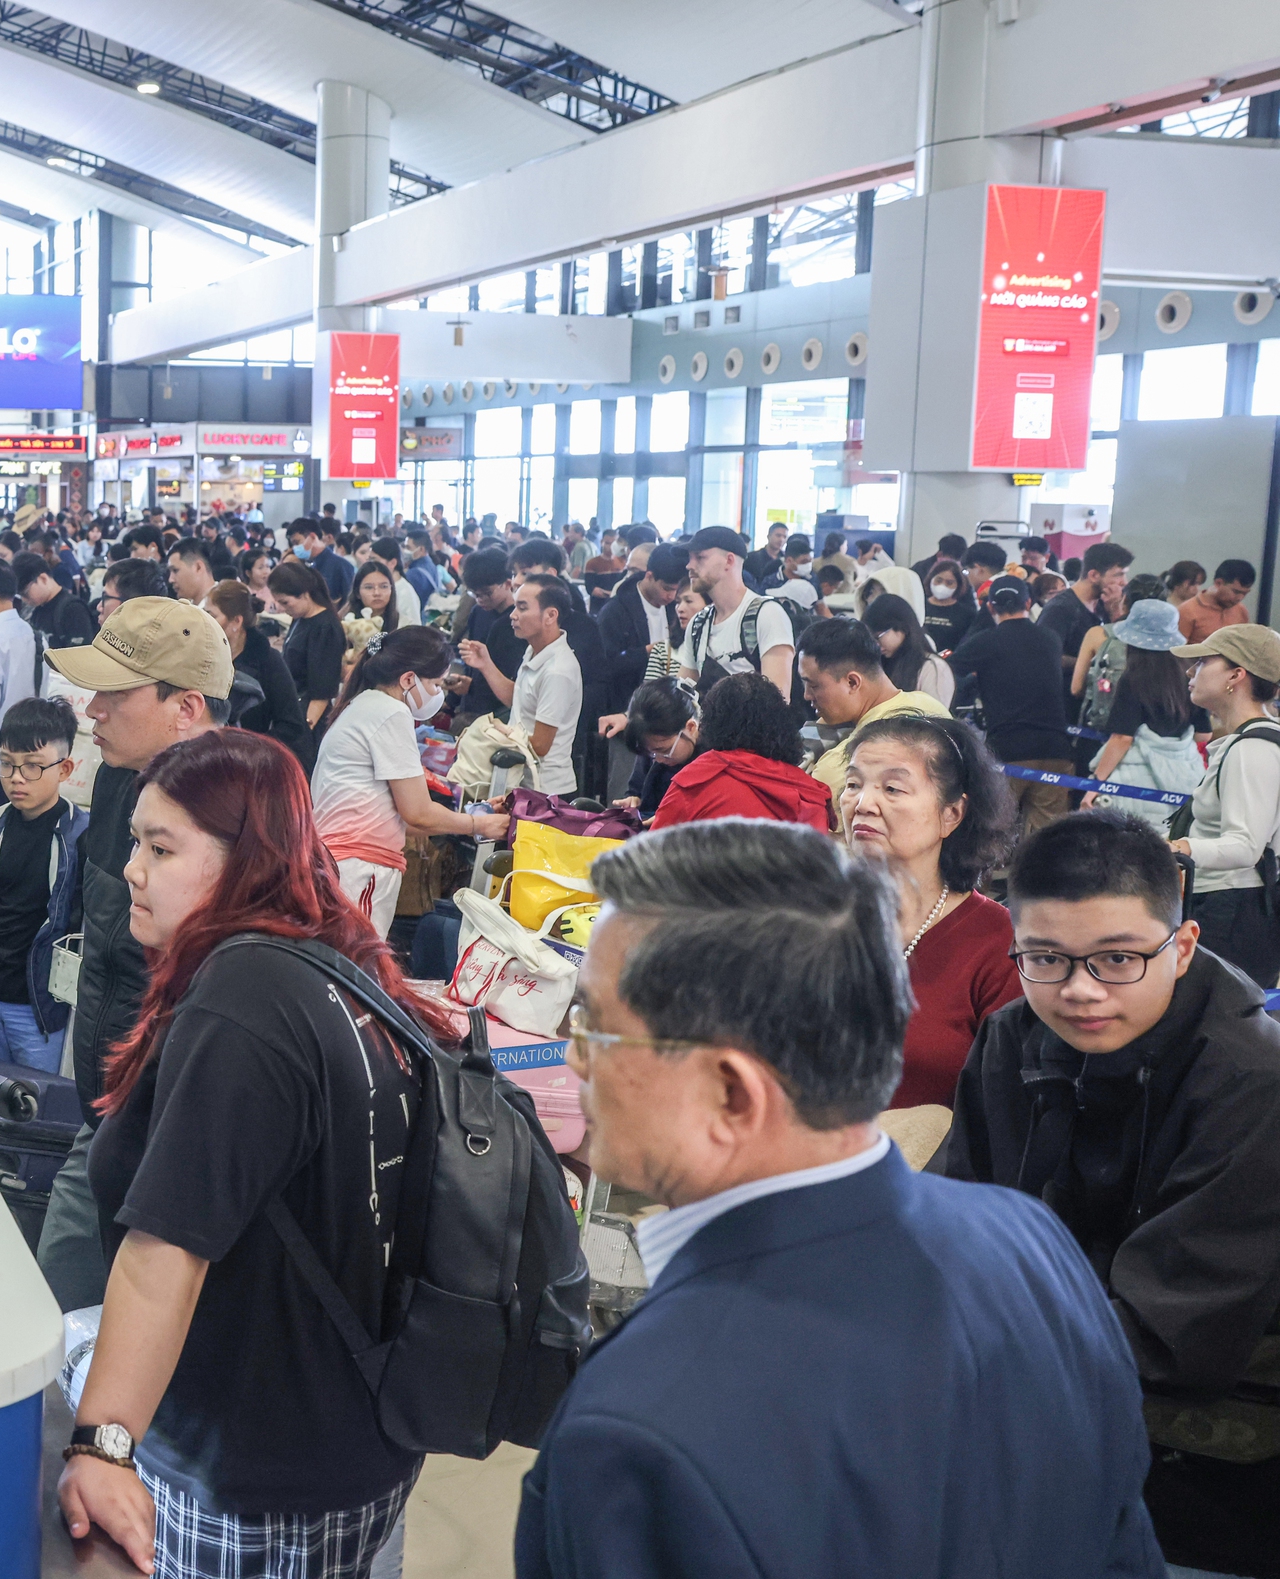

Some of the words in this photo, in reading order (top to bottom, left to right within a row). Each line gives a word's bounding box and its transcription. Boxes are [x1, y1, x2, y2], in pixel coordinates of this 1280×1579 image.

[1009, 274, 1072, 290] Advertising
[204, 433, 250, 446] LUCKY
[251, 434, 287, 446] CAFE
[30, 461, 62, 475] CAFE
[101, 629, 135, 658] FASHION
[1040, 773, 1061, 783] ACV
[1098, 783, 1119, 794] ACV
[1160, 793, 1183, 804] ACV
